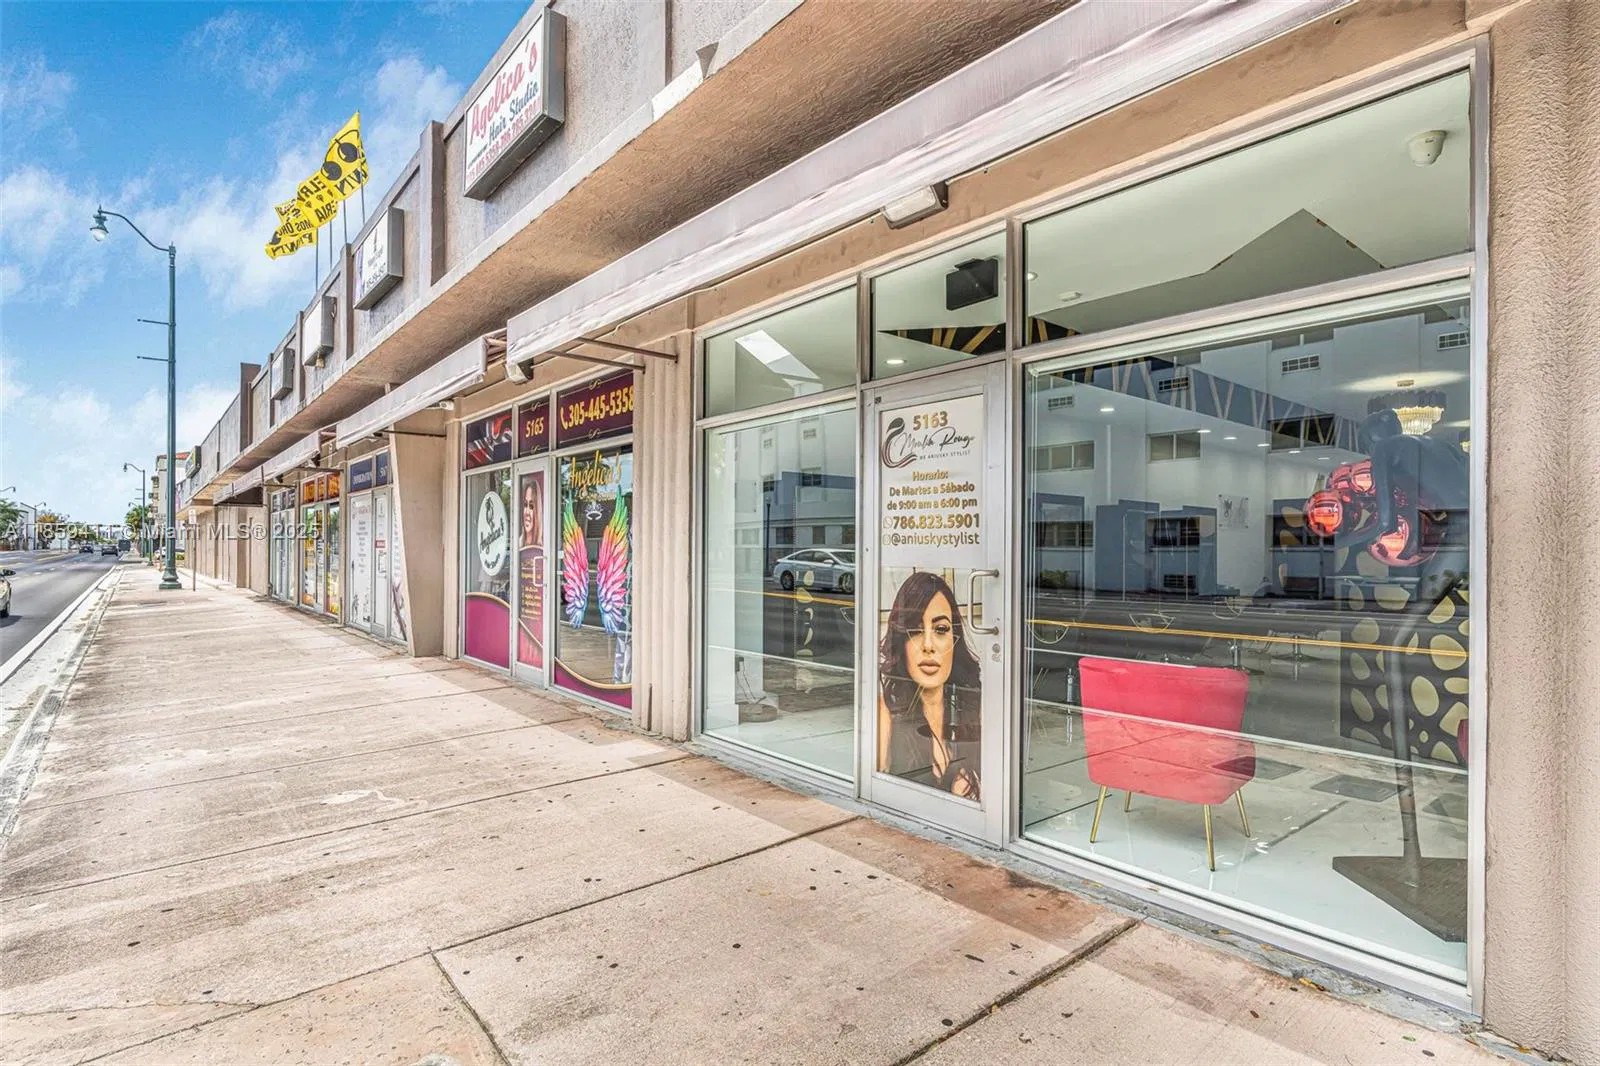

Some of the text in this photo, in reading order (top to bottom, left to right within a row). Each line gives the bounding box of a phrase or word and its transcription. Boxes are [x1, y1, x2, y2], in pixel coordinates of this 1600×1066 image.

[489, 81, 539, 145] Hair Studio
[569, 385, 634, 428] 305-445-5358
[525, 417, 544, 438] 5165
[913, 410, 948, 431] 5163
[912, 469, 949, 482] Horario:
[889, 487, 900, 497] De
[901, 485, 931, 496] Martes
[940, 481, 975, 494] Sábado
[887, 501, 897, 511] de
[898, 500, 916, 510] 9:00
[918, 501, 931, 509] am
[940, 498, 960, 508] 6:00
[961, 499, 978, 510] pm
[892, 513, 980, 530] 786.823.5901
[891, 532, 980, 548] @aniuskystylist
